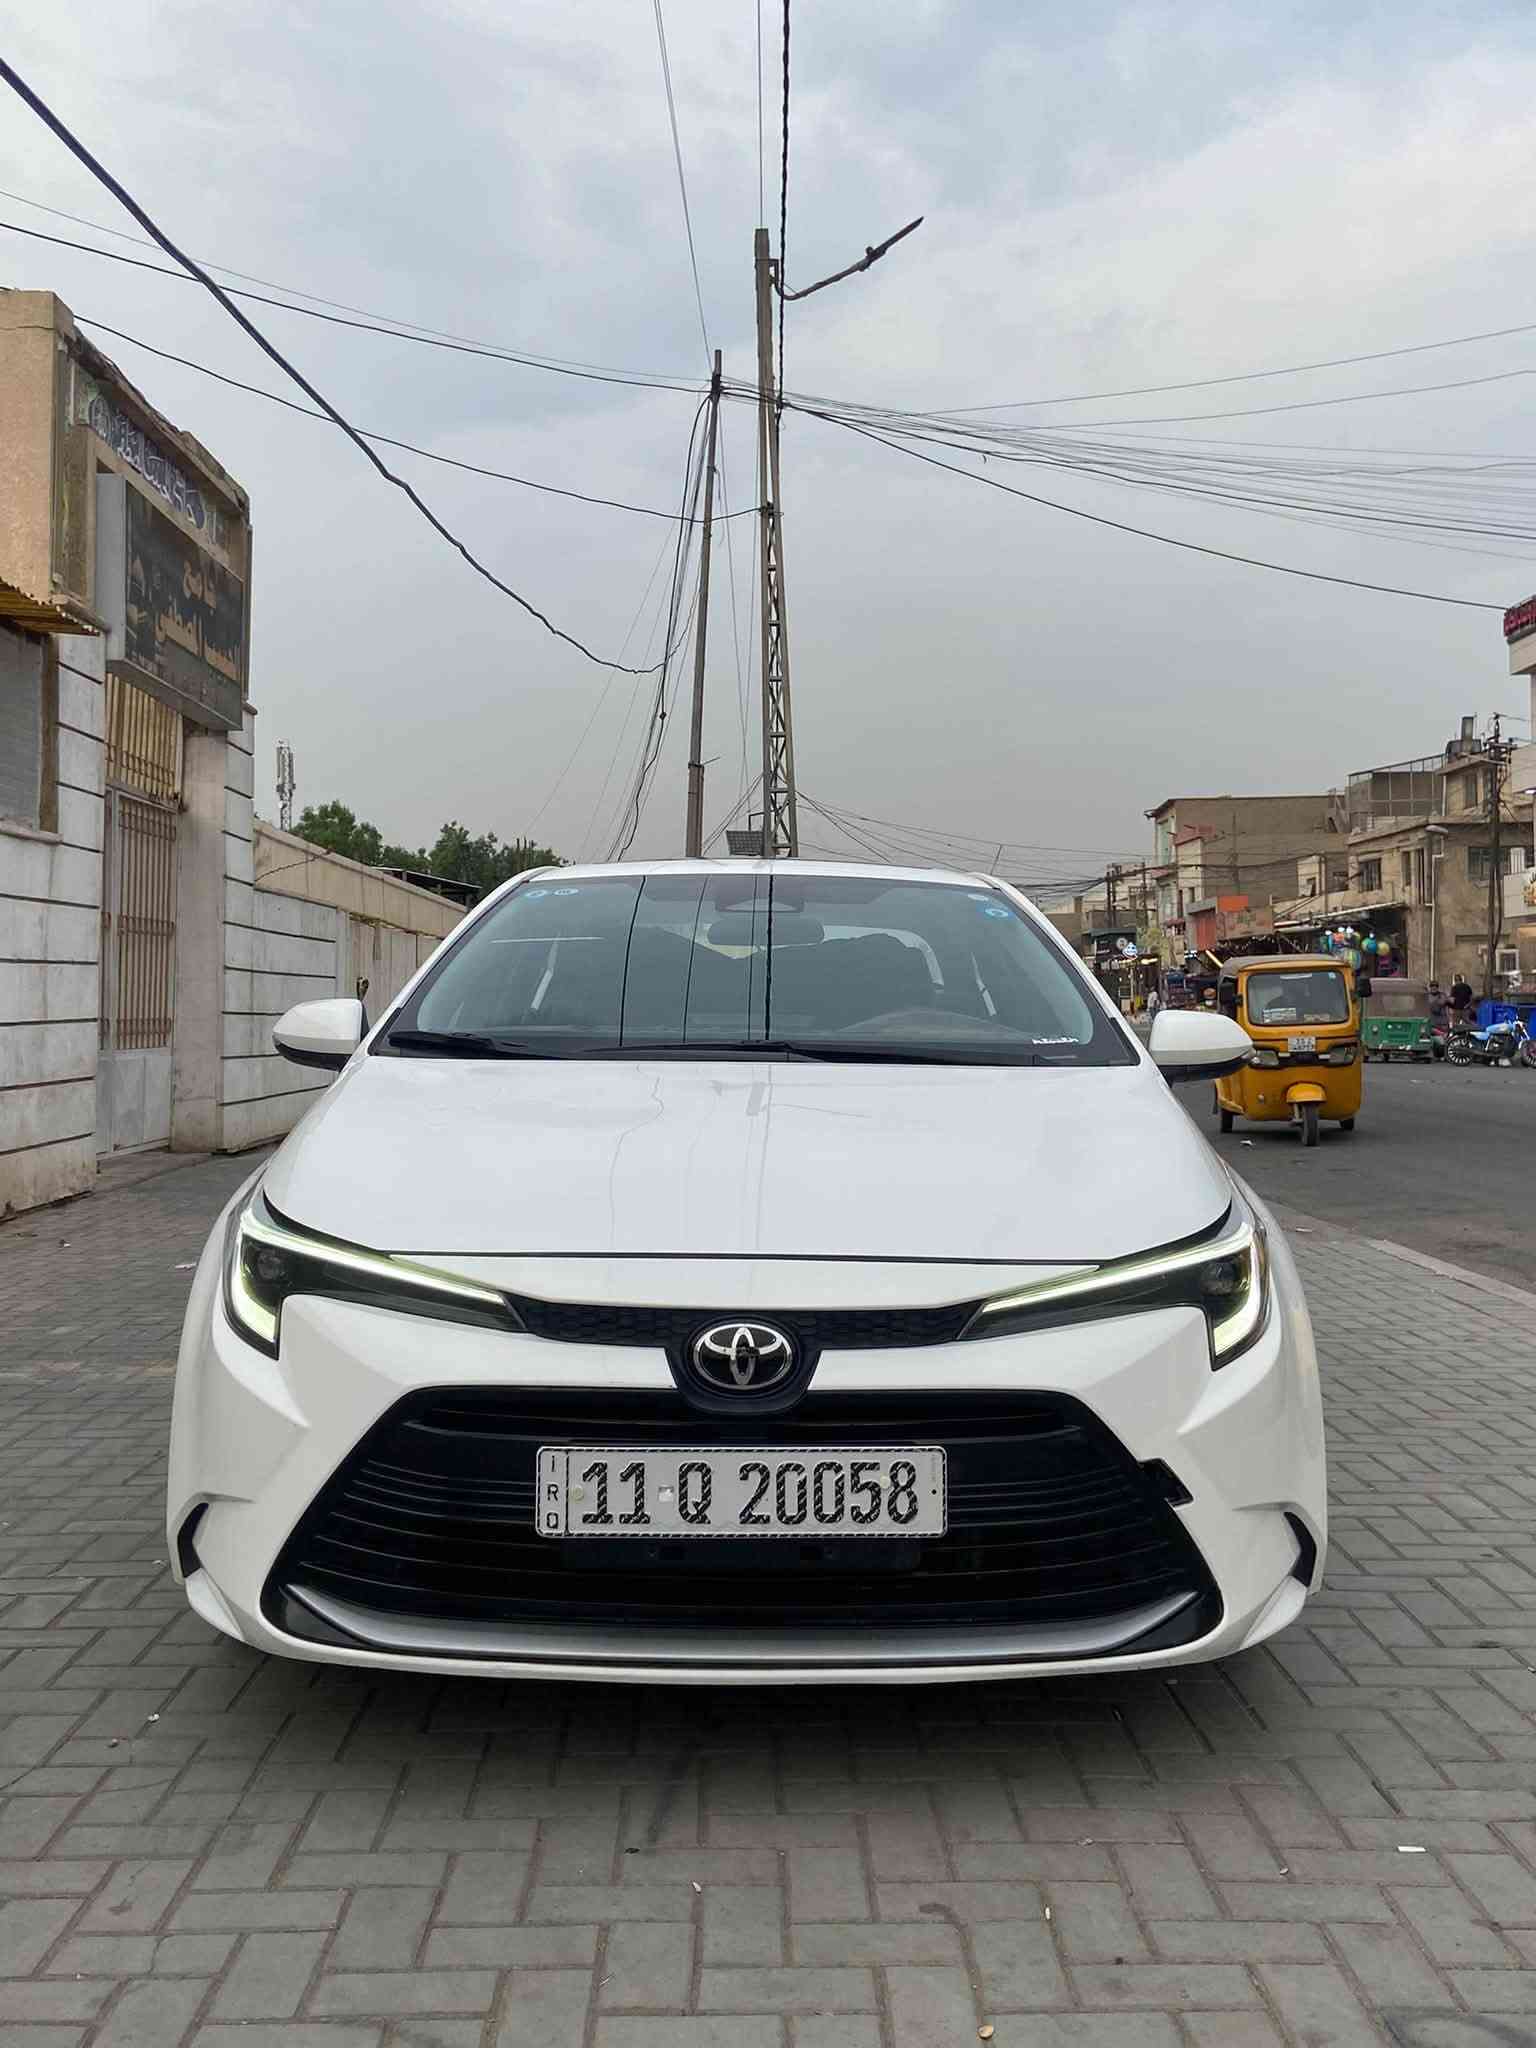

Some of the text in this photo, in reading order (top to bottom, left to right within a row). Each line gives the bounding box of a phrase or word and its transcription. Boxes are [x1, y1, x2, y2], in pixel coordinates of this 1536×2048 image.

[546, 1455, 559, 1529] IRQ
[582, 1462, 650, 1524] 11
[678, 1462, 712, 1524] Q
[739, 1461, 918, 1524] 20058
